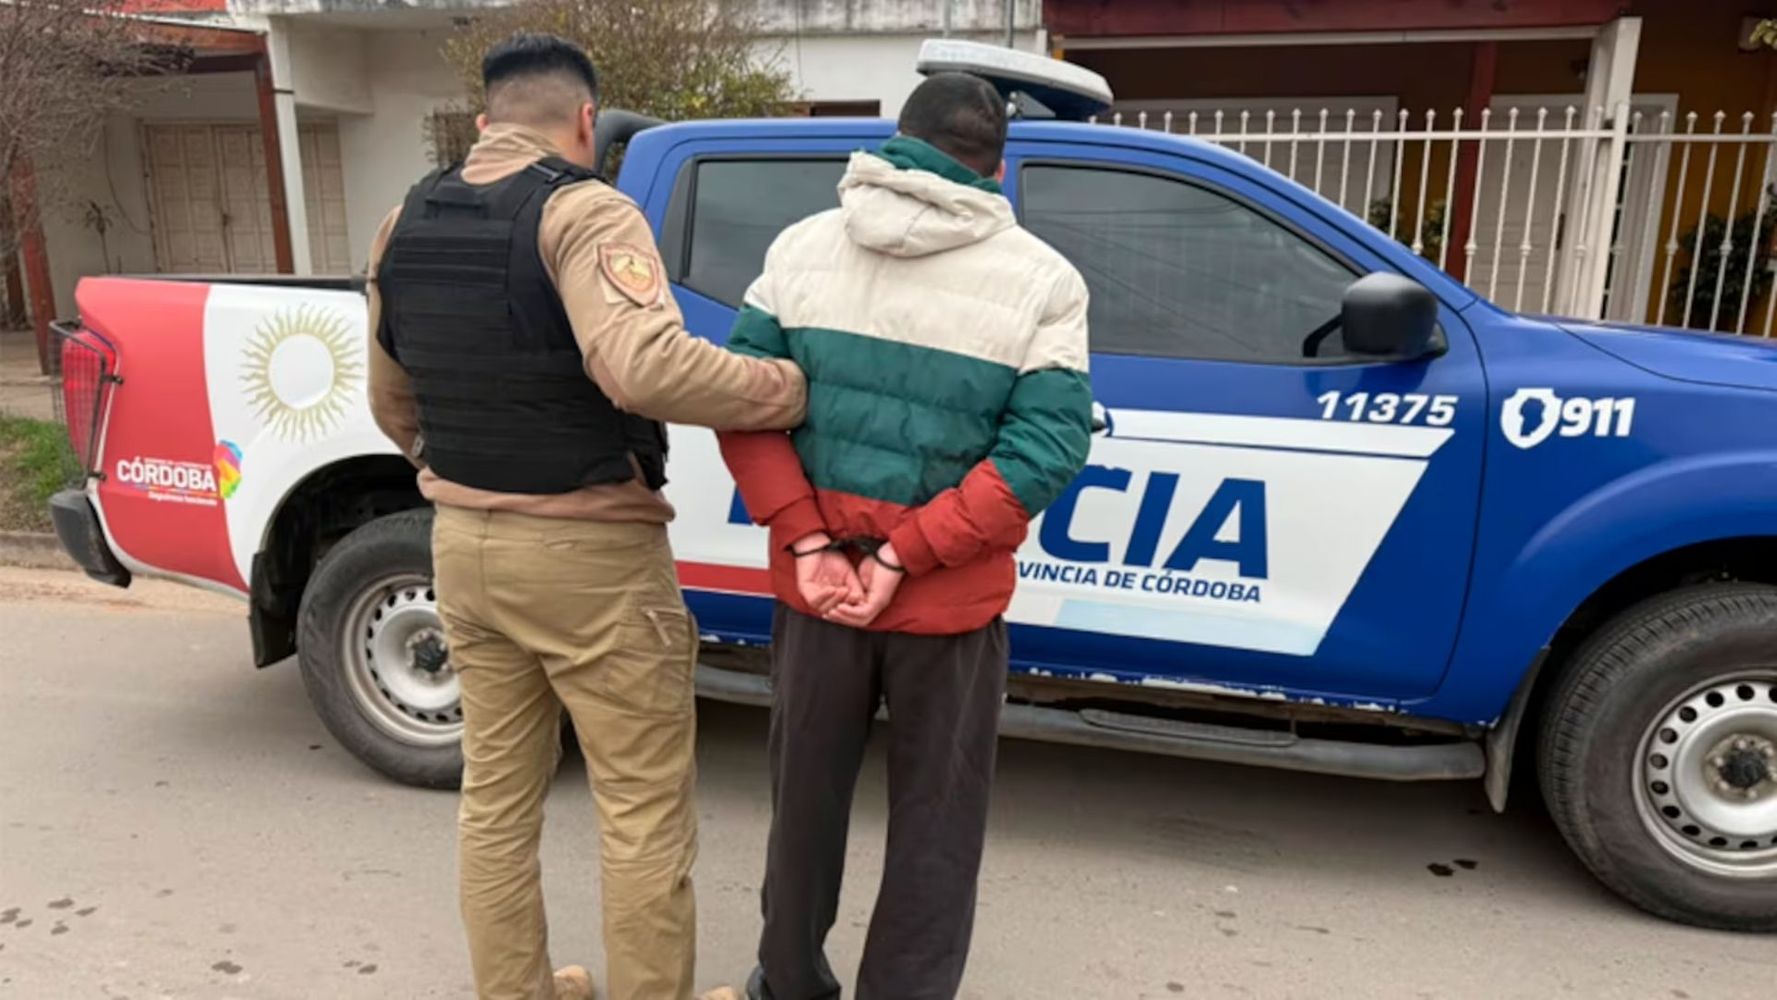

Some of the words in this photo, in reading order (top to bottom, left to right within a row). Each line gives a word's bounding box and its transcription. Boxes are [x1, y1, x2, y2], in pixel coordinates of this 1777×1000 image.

[1317, 390, 1459, 426] 11375
[1559, 397, 1635, 437] 911
[116, 456, 217, 492] CÓRDOBA
[1019, 561, 1098, 586] VINCIA
[1103, 570, 1138, 590] DE
[1141, 568, 1261, 603] CÓRDOBA
